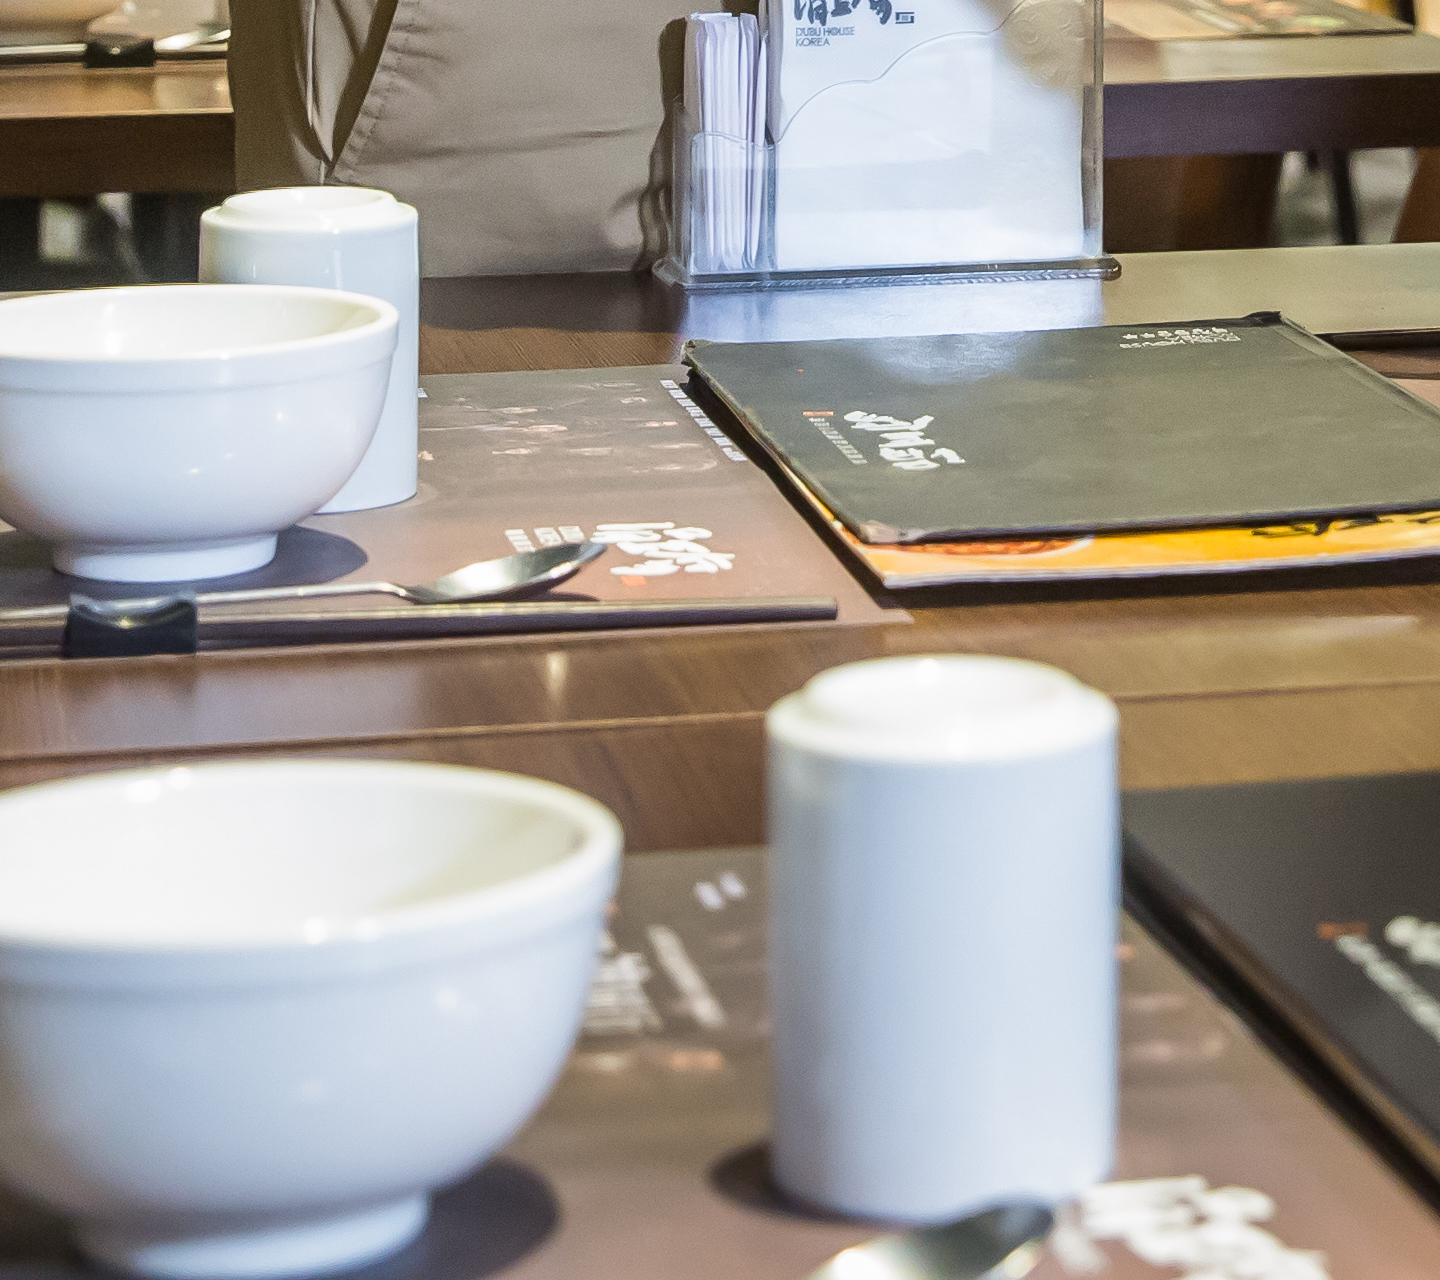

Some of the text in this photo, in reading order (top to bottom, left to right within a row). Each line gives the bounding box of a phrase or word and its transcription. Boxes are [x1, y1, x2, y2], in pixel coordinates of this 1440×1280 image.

[795, 26, 855, 37] DUBU HOUSE
[795, 37, 830, 47] KOREA
